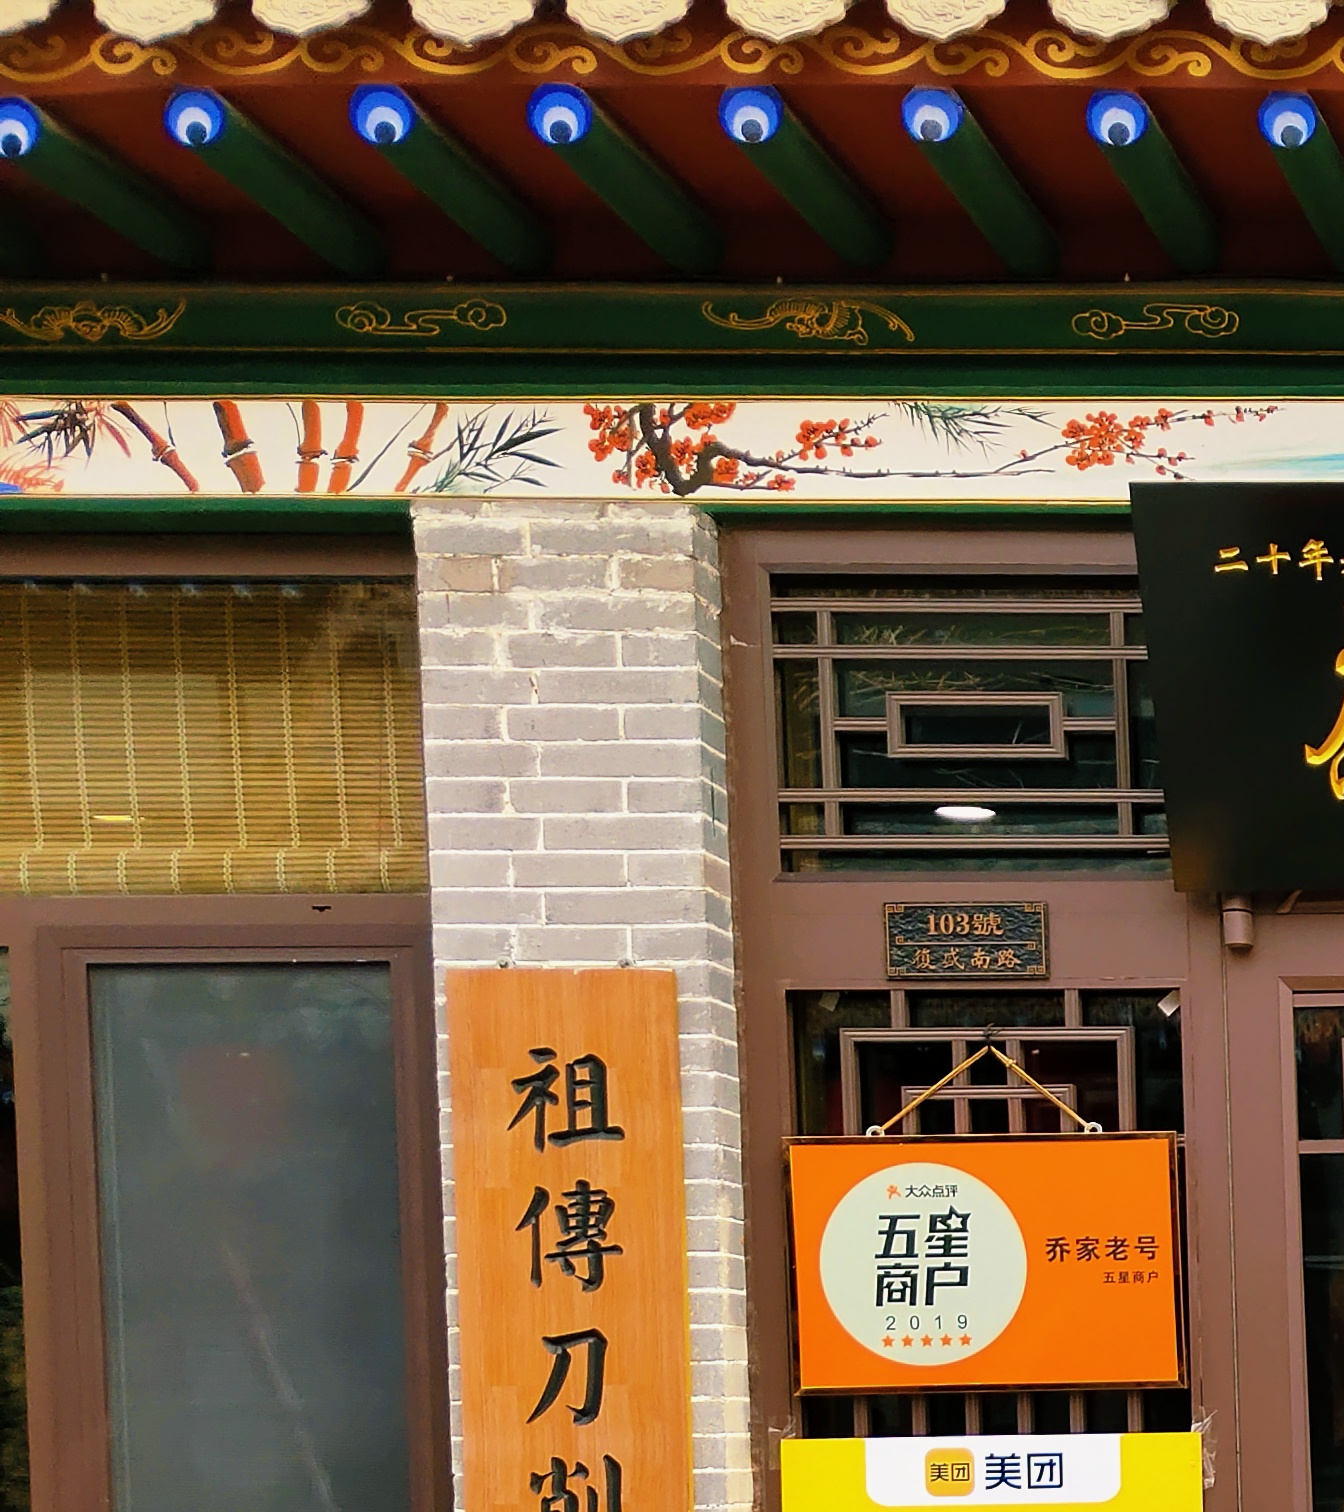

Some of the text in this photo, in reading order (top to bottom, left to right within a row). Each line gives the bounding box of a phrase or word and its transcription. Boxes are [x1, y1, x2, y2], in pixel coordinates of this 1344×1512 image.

[927, 912, 1004, 936] 103號
[904, 1184, 959, 1199] 大众点评
[874, 1205, 972, 1260] 五星
[1044, 1236, 1160, 1263] 乔家老号
[875, 1261, 970, 1307] 商户
[1102, 1270, 1159, 1285] 五星商户
[884, 1314, 969, 1331] 2019
[929, 1463, 971, 1482] 美团
[984, 1452, 1064, 1491] 美团
